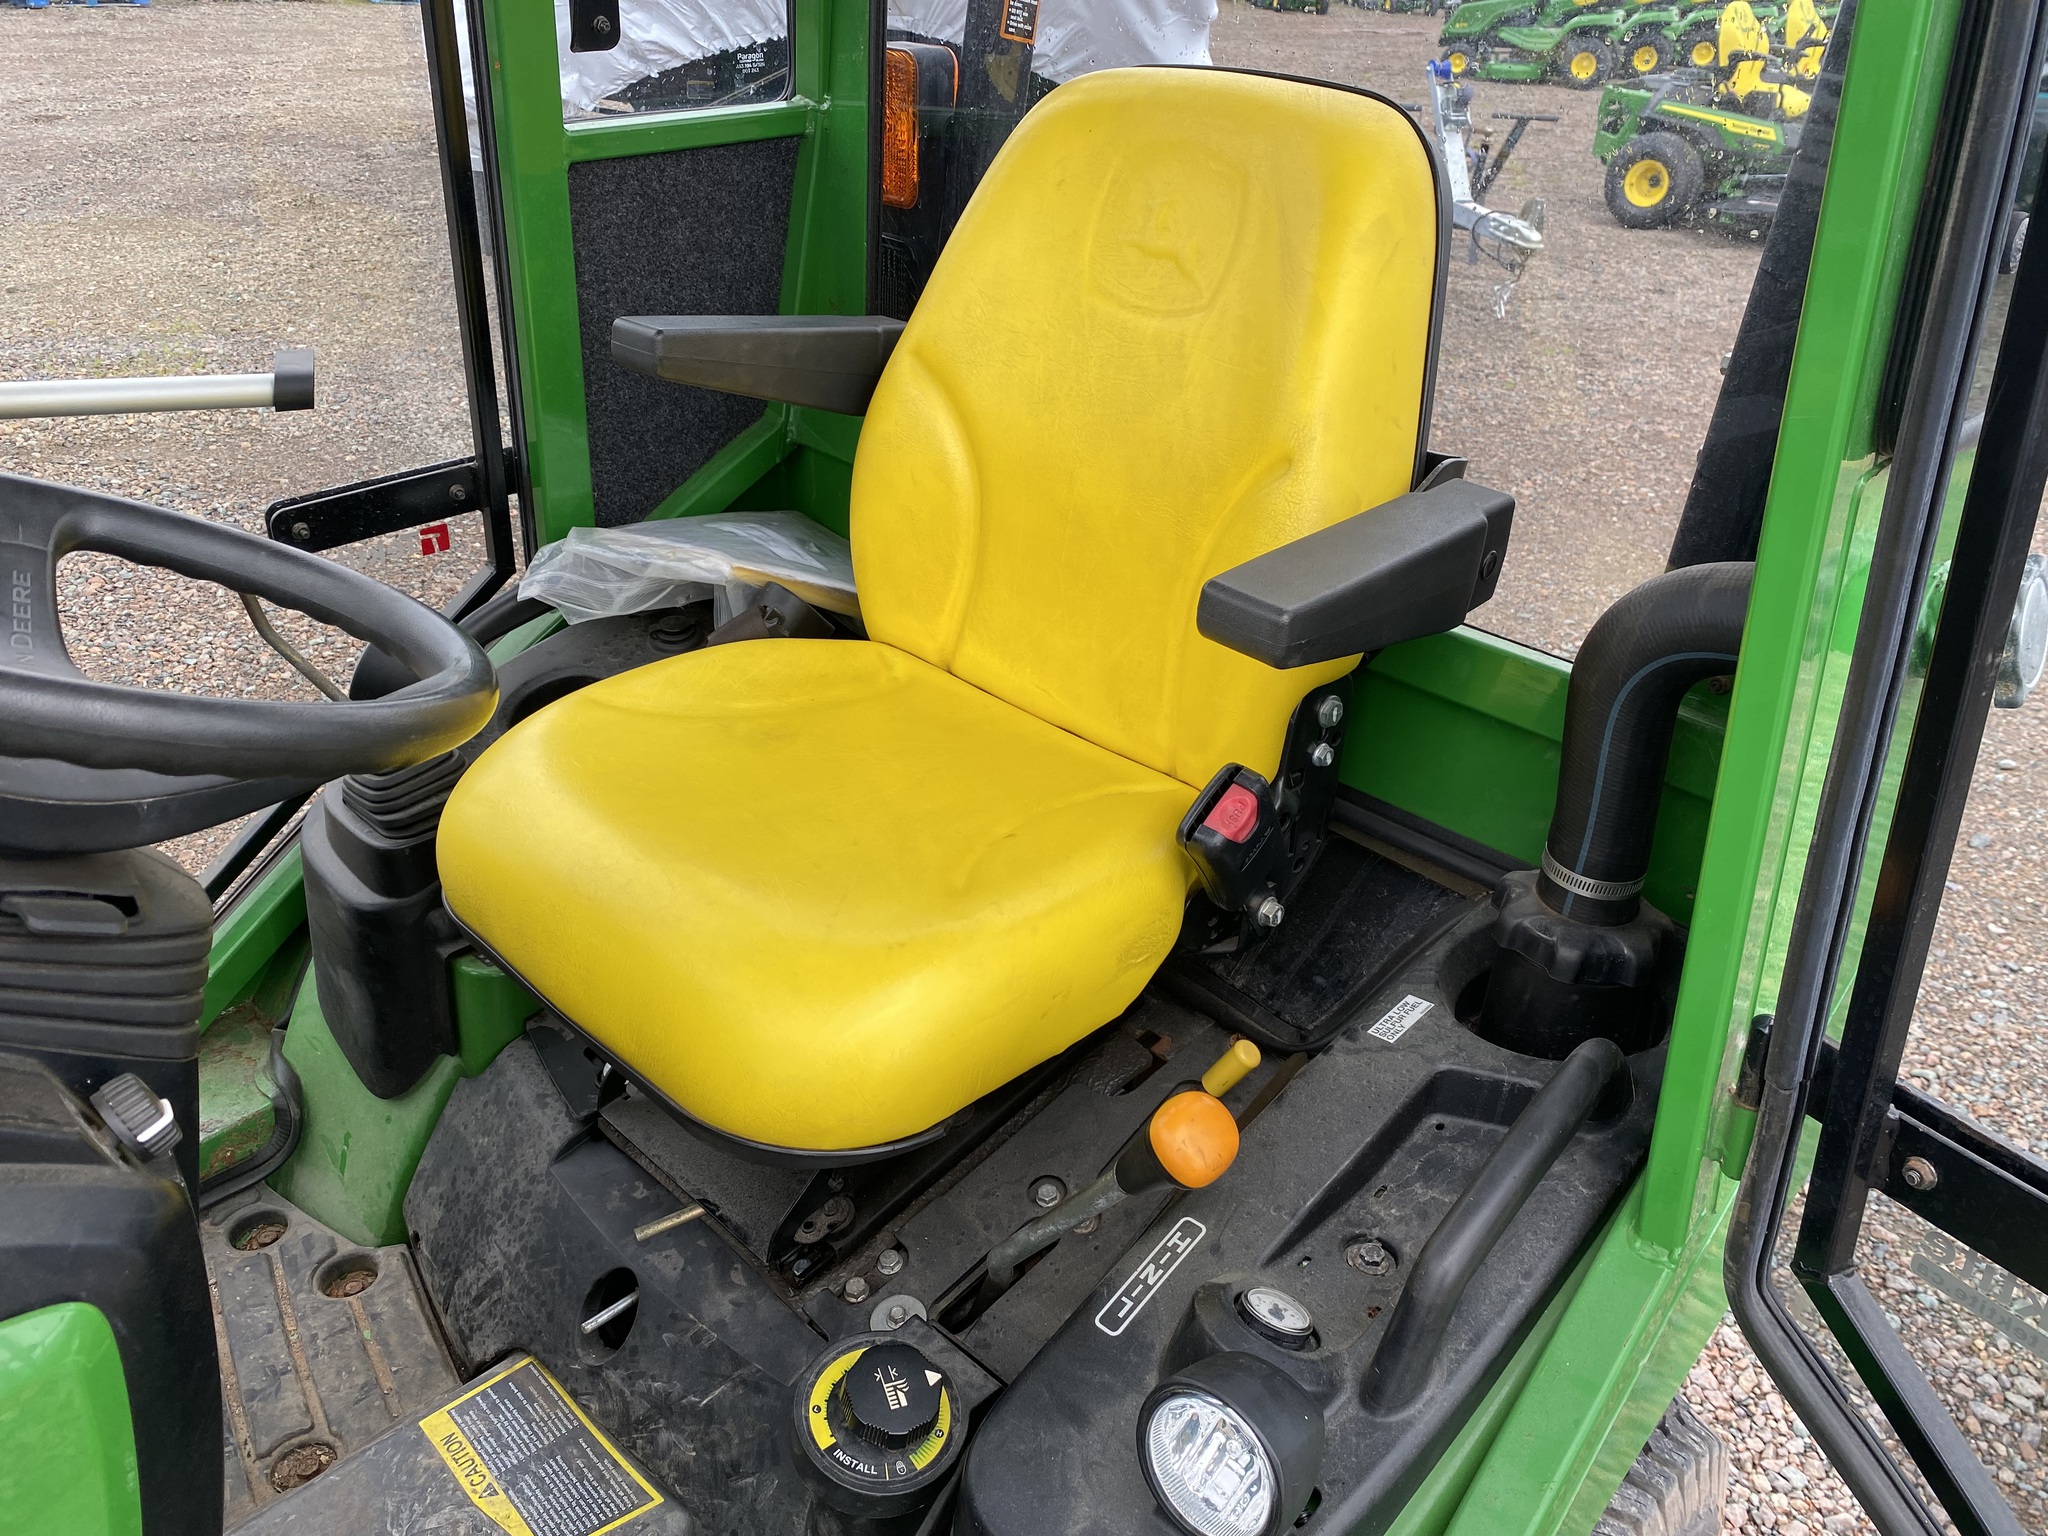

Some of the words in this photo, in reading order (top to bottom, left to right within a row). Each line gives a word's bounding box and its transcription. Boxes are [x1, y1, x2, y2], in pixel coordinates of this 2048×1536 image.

[737, 52, 764, 62] Paragon
[10, 569, 33, 650] DEERE
[1371, 1014, 1395, 1035] ULTRA
[1394, 1000, 1411, 1015] LOW
[1379, 1013, 1407, 1037] SULFUR
[1404, 1000, 1424, 1016] FUEL
[1386, 1024, 1406, 1041] ONLY
[440, 1432, 484, 1487] CAUTION
[833, 1448, 878, 1475] INSTALL
